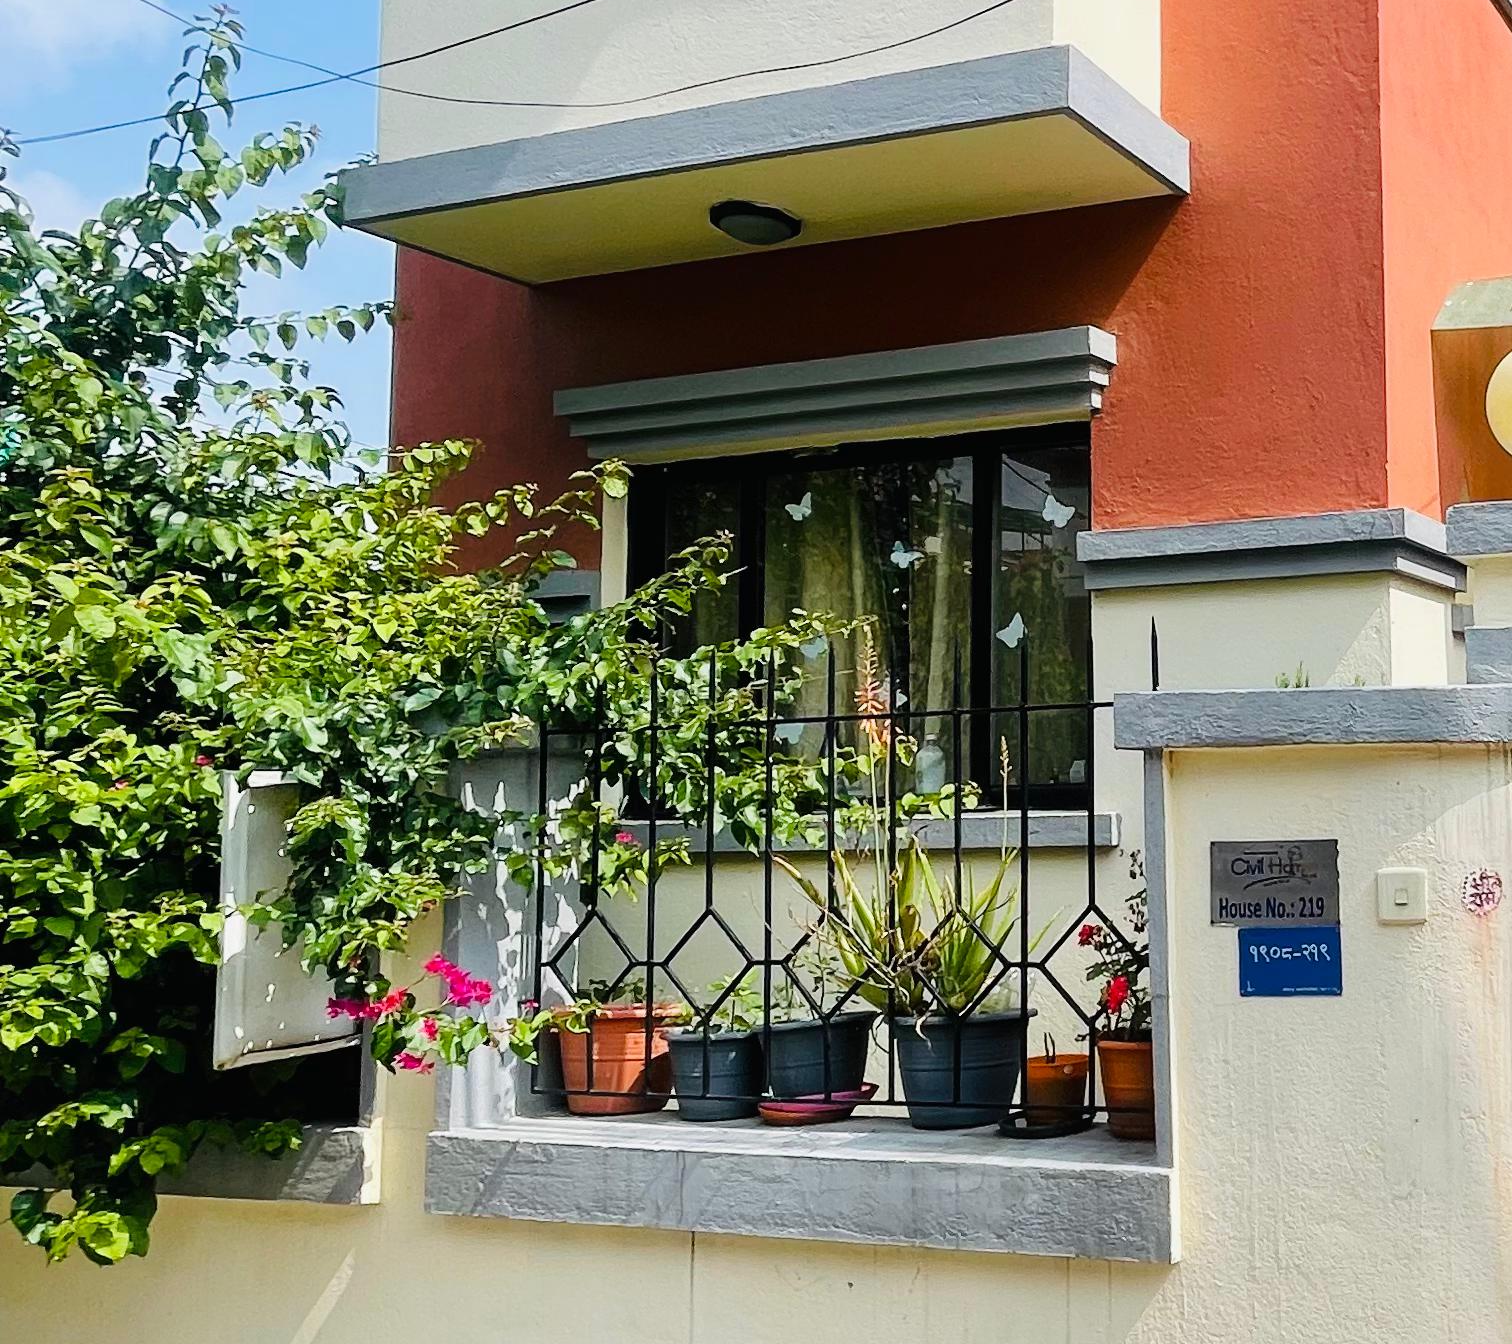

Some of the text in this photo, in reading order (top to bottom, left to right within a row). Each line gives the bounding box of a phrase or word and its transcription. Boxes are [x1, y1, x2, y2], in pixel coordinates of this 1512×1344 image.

[1231, 857, 1265, 876] Civil
[1219, 896, 1325, 919] House No.: 219
